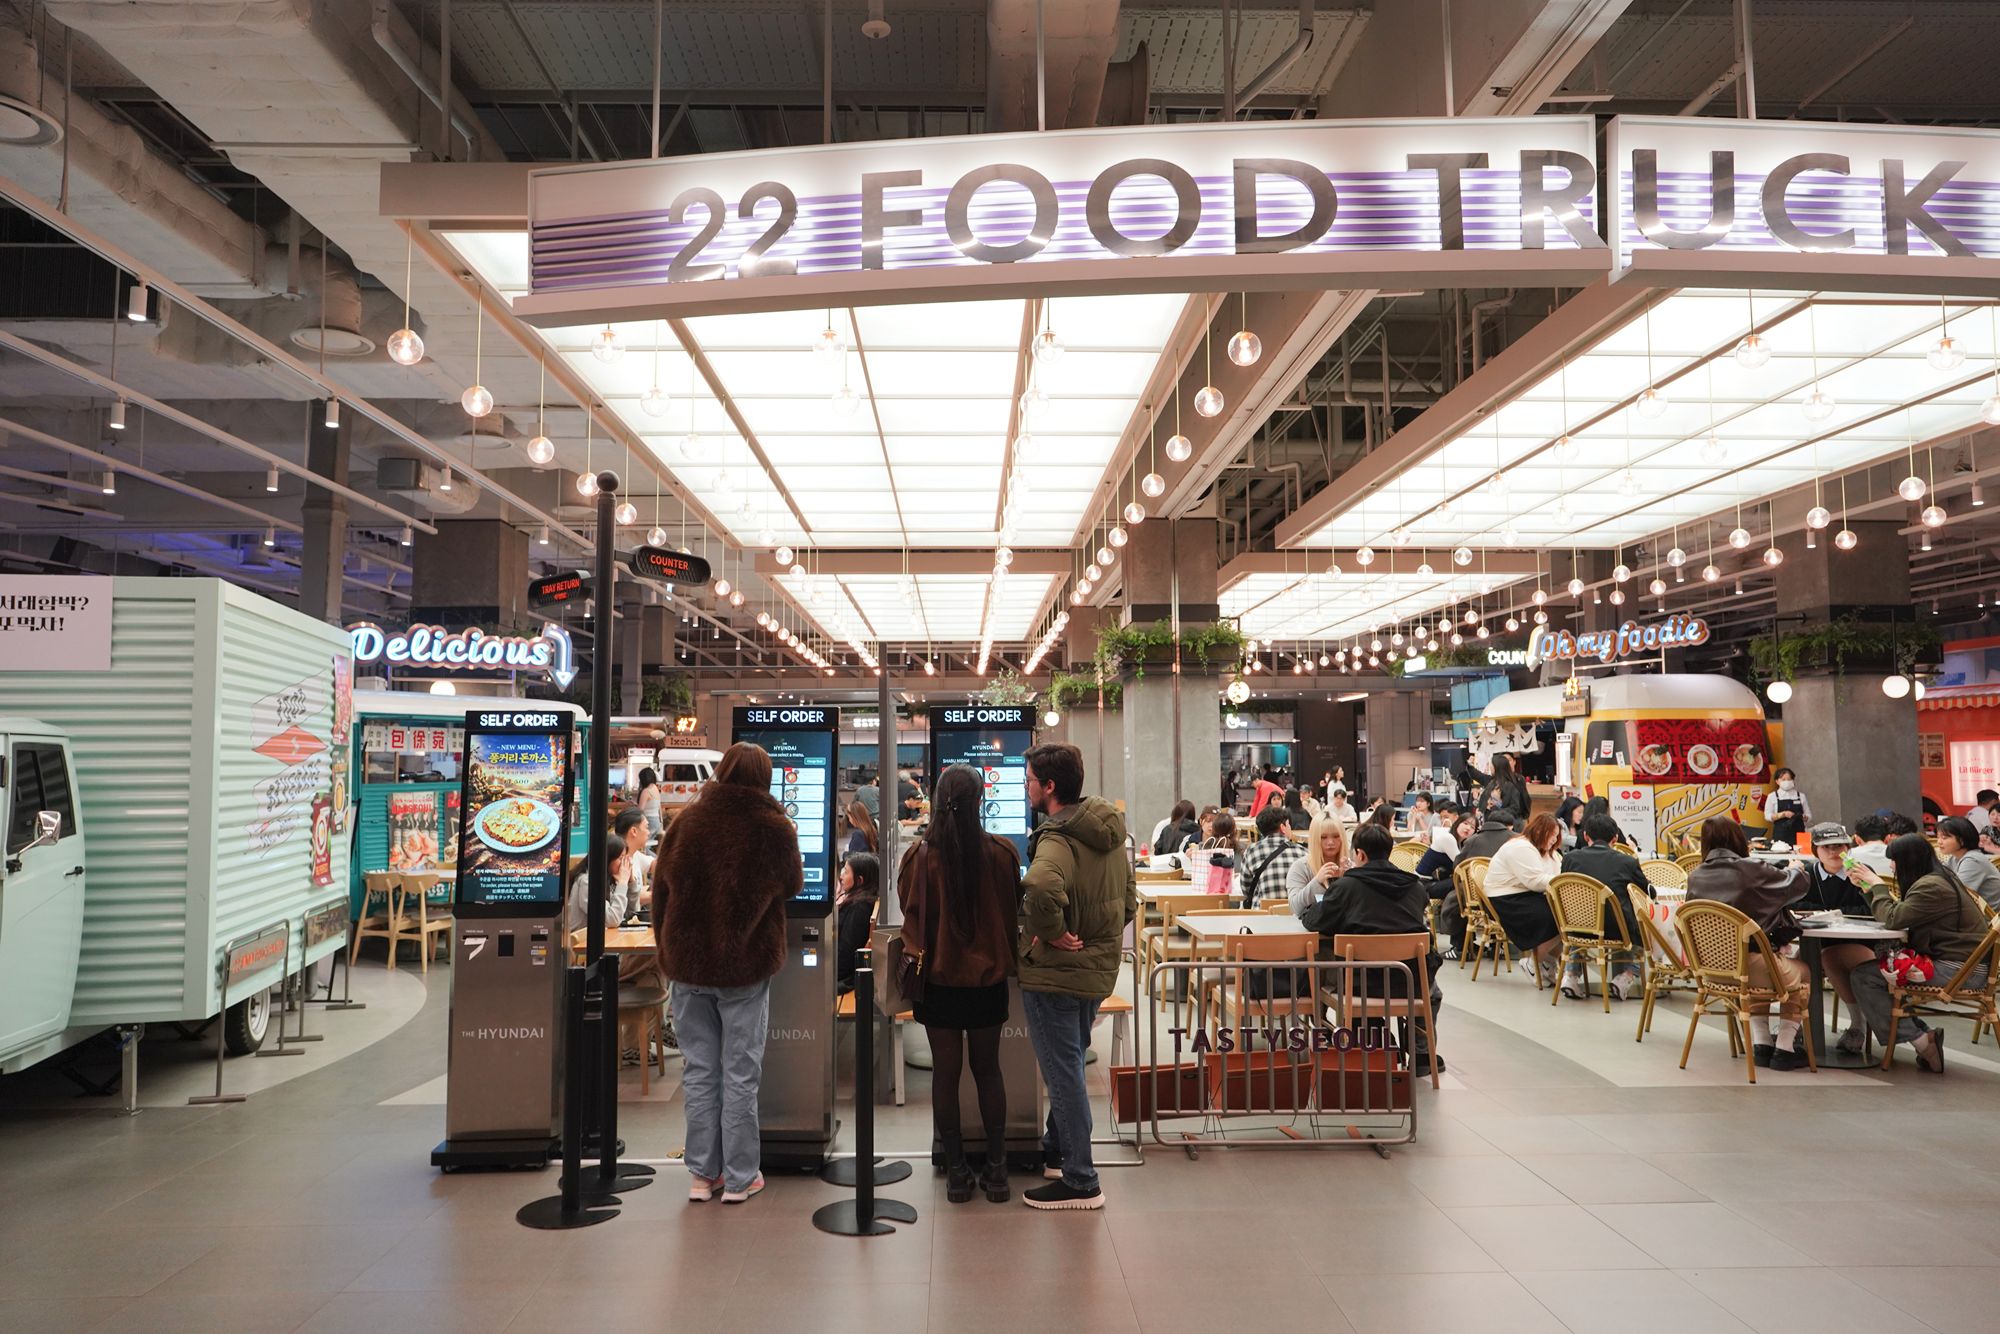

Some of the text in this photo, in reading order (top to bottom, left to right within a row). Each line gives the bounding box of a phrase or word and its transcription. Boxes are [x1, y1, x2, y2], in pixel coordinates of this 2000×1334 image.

[667, 147, 1978, 284] 22 FOOD TRUCK
[650, 554, 689, 571] COUNTER
[541, 578, 580, 595] TRAY RETURN
[1541, 616, 1702, 660] Oh my foodie
[353, 626, 550, 666] Delicious
[1488, 650, 1528, 665] COUN
[1564, 678, 1581, 696] #3
[480, 714, 558, 726] SELF ORDER
[748, 710, 824, 722] SELF ORDER
[944, 710, 1022, 722] SELF ORDER
[676, 717, 698, 732] #7
[519, 752, 548, 763] 돈까스
[478, 1028, 544, 1039] HYUNDAI
